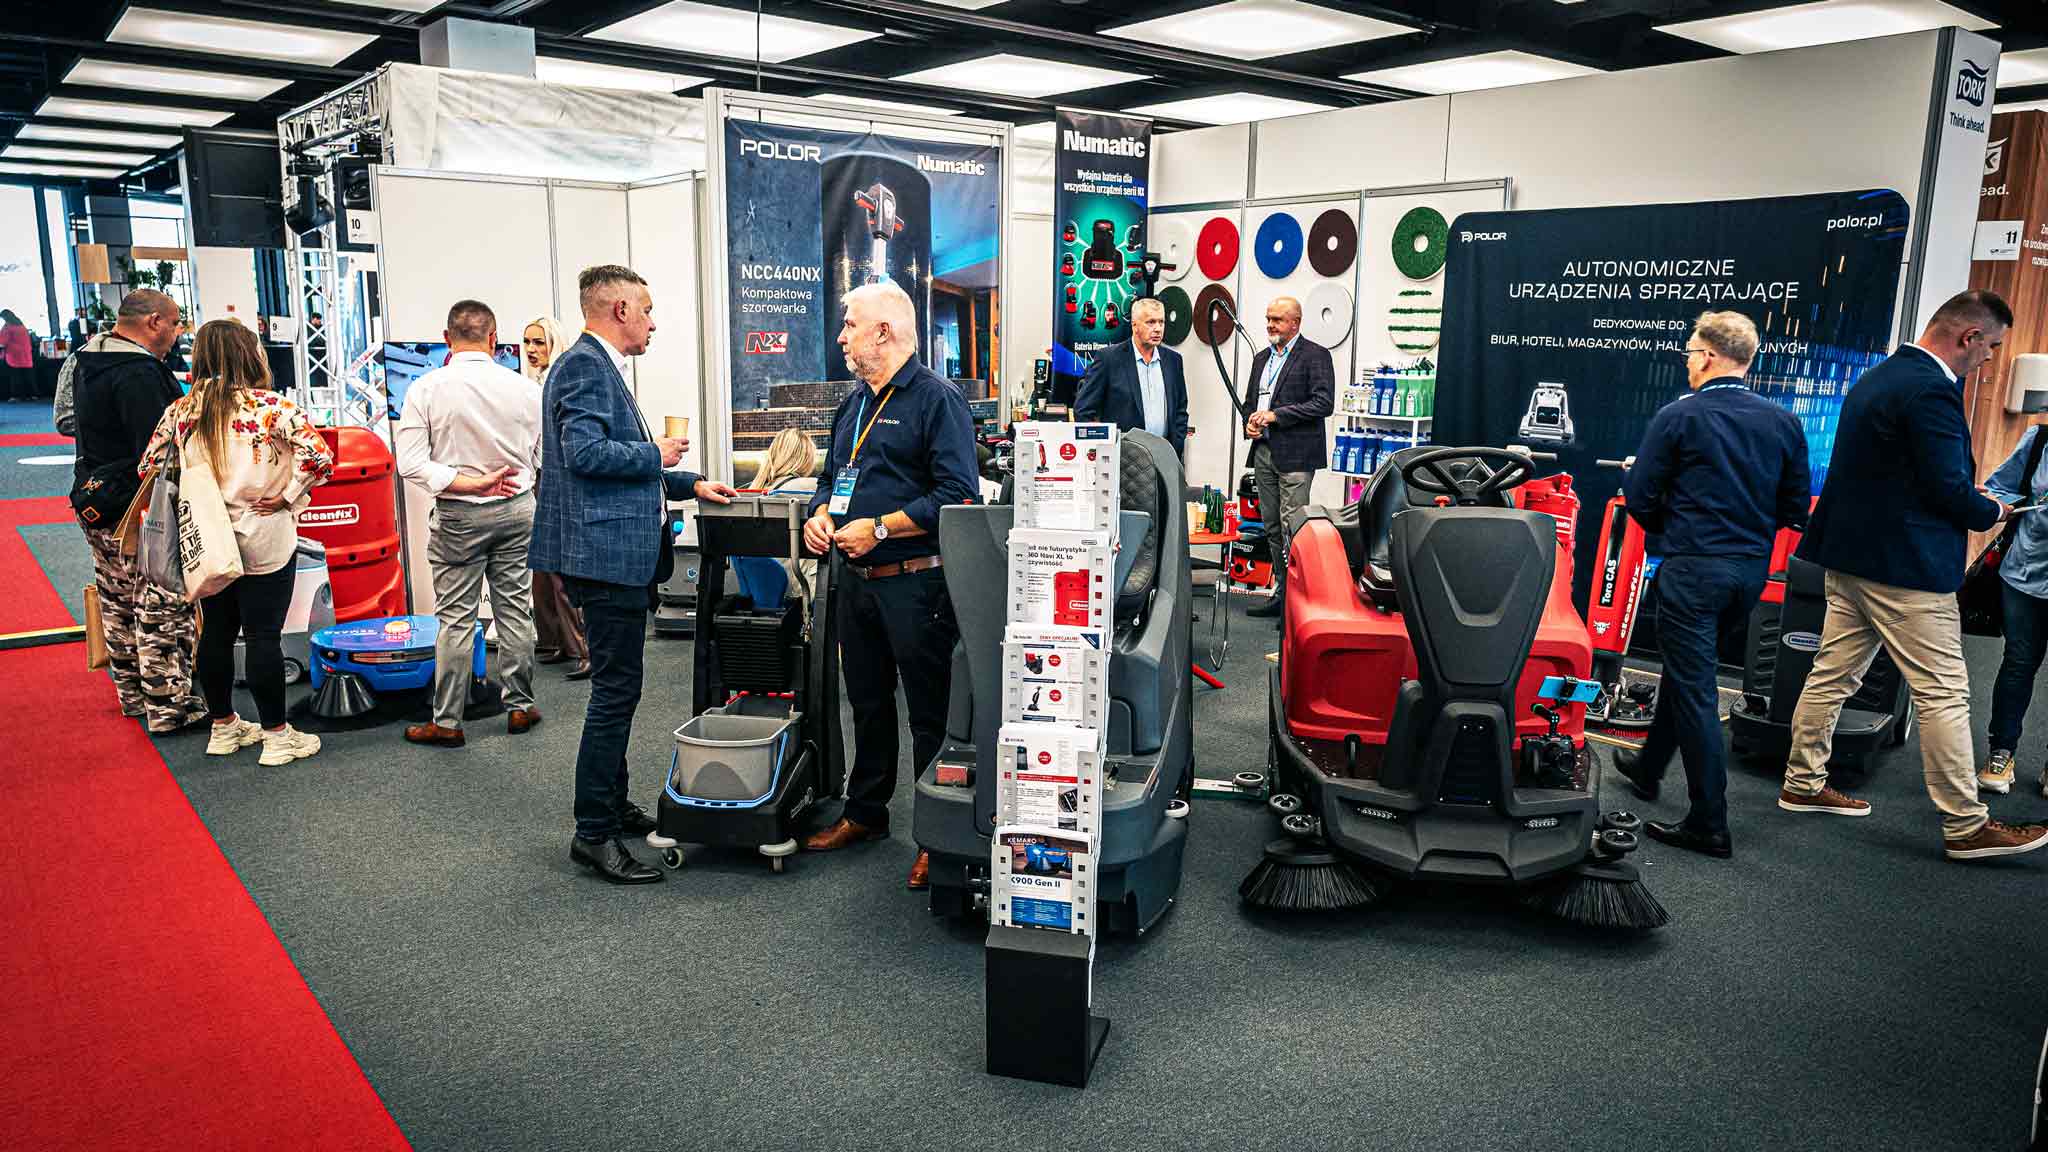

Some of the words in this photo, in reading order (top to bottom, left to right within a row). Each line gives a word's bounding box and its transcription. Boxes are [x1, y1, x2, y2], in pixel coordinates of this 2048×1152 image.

[1958, 74, 1985, 101] TORK
[1950, 111, 1967, 129] Think
[740, 139, 821, 164] POLOR
[1063, 130, 1146, 158] Numatic
[917, 154, 985, 176] Numatic
[1123, 186, 1137, 196] serii
[1981, 183, 2010, 197] ead.
[351, 218, 361, 230] 10
[1826, 212, 1884, 232] polor.pl
[1474, 232, 1507, 241] POLOR
[2006, 230, 2018, 244] 11
[741, 263, 821, 282] NCC440NX
[1562, 259, 1736, 278] AUTONOMICZNE
[741, 286, 812, 301] Kompaktowa
[1509, 283, 1632, 302] URZĄDZENIA
[1639, 281, 1800, 303] SPRZĄTAJĄCE
[742, 302, 807, 314] szorowarka
[272, 322, 278, 331] 9
[1593, 318, 1666, 330] DEDYKOWANE
[1668, 320, 1688, 330] DO:
[1490, 334, 1520, 346] BIUR,
[1521, 336, 1564, 348] HOTELI,
[1567, 336, 1653, 352] MAGAZYNÓW,
[1656, 341, 1682, 351] HAL
[300, 508, 353, 521] cleanfix
[1605, 559, 1617, 582] CAS
[1601, 582, 1614, 605] Toro
[1620, 562, 1640, 639] cleanfix
[1035, 878, 1053, 887] Gen
